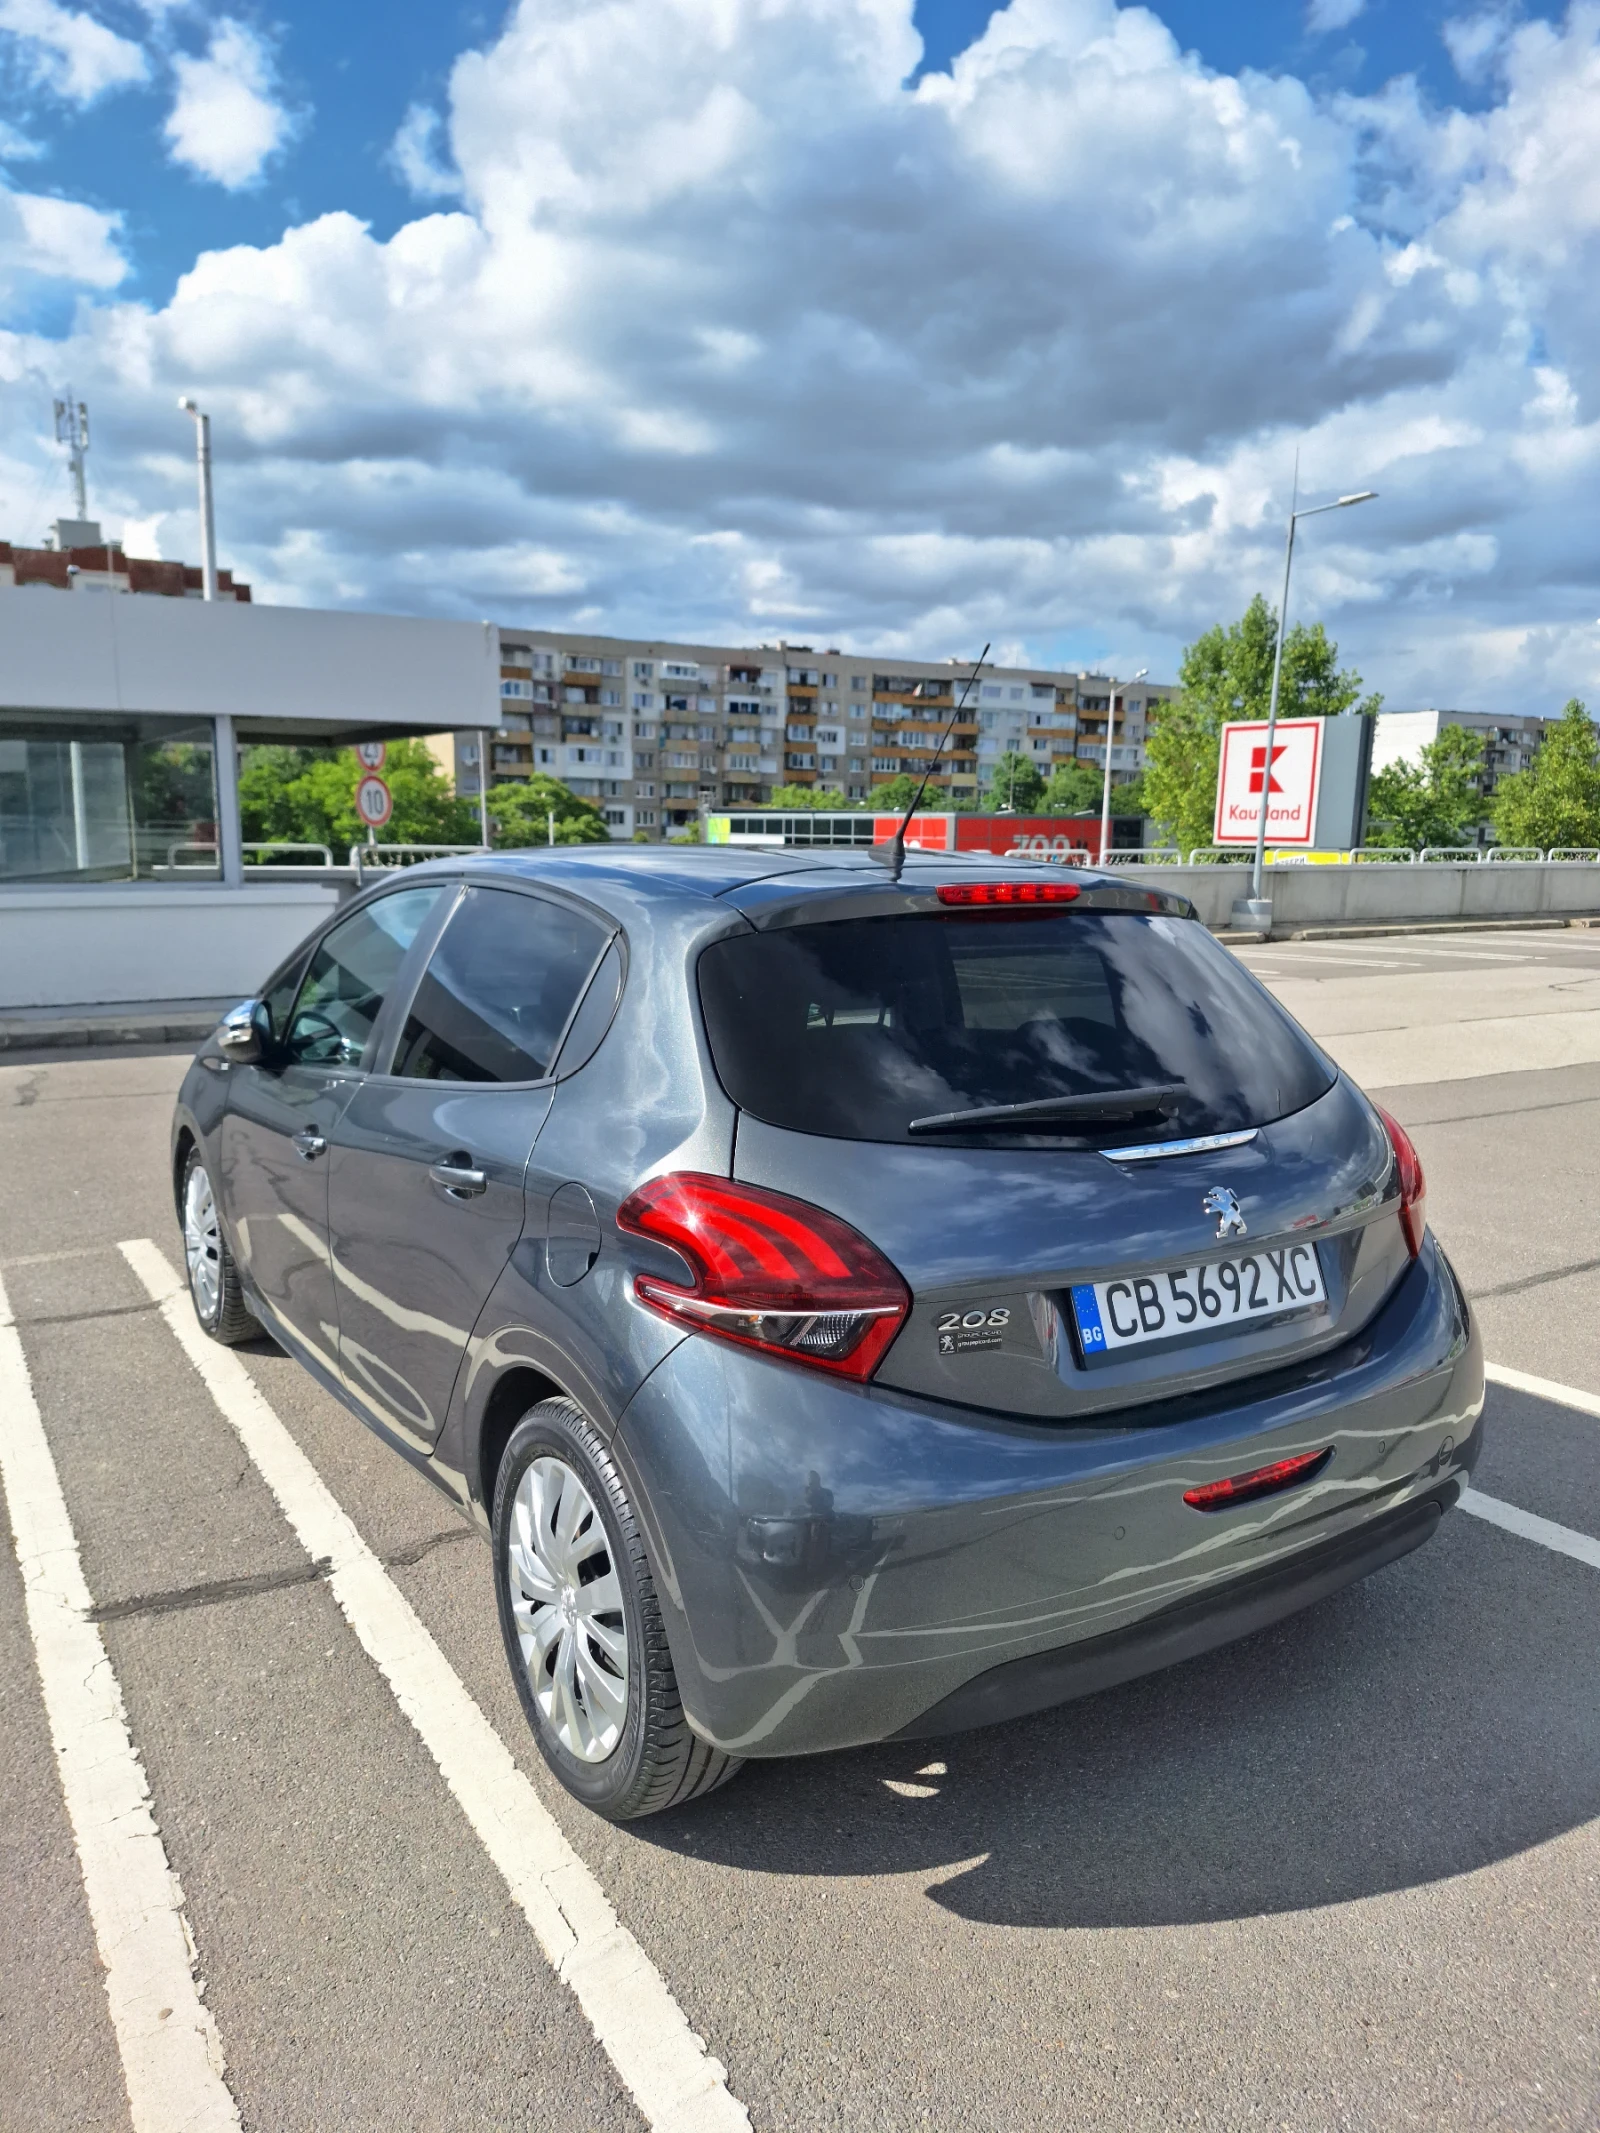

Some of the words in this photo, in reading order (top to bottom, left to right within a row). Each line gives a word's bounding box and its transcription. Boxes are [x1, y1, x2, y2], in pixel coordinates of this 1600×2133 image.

[366, 790, 384, 814] 10
[1229, 804, 1301, 820] Kauland
[938, 1307, 1011, 1331] 208
[1083, 1327, 1103, 1344] BG
